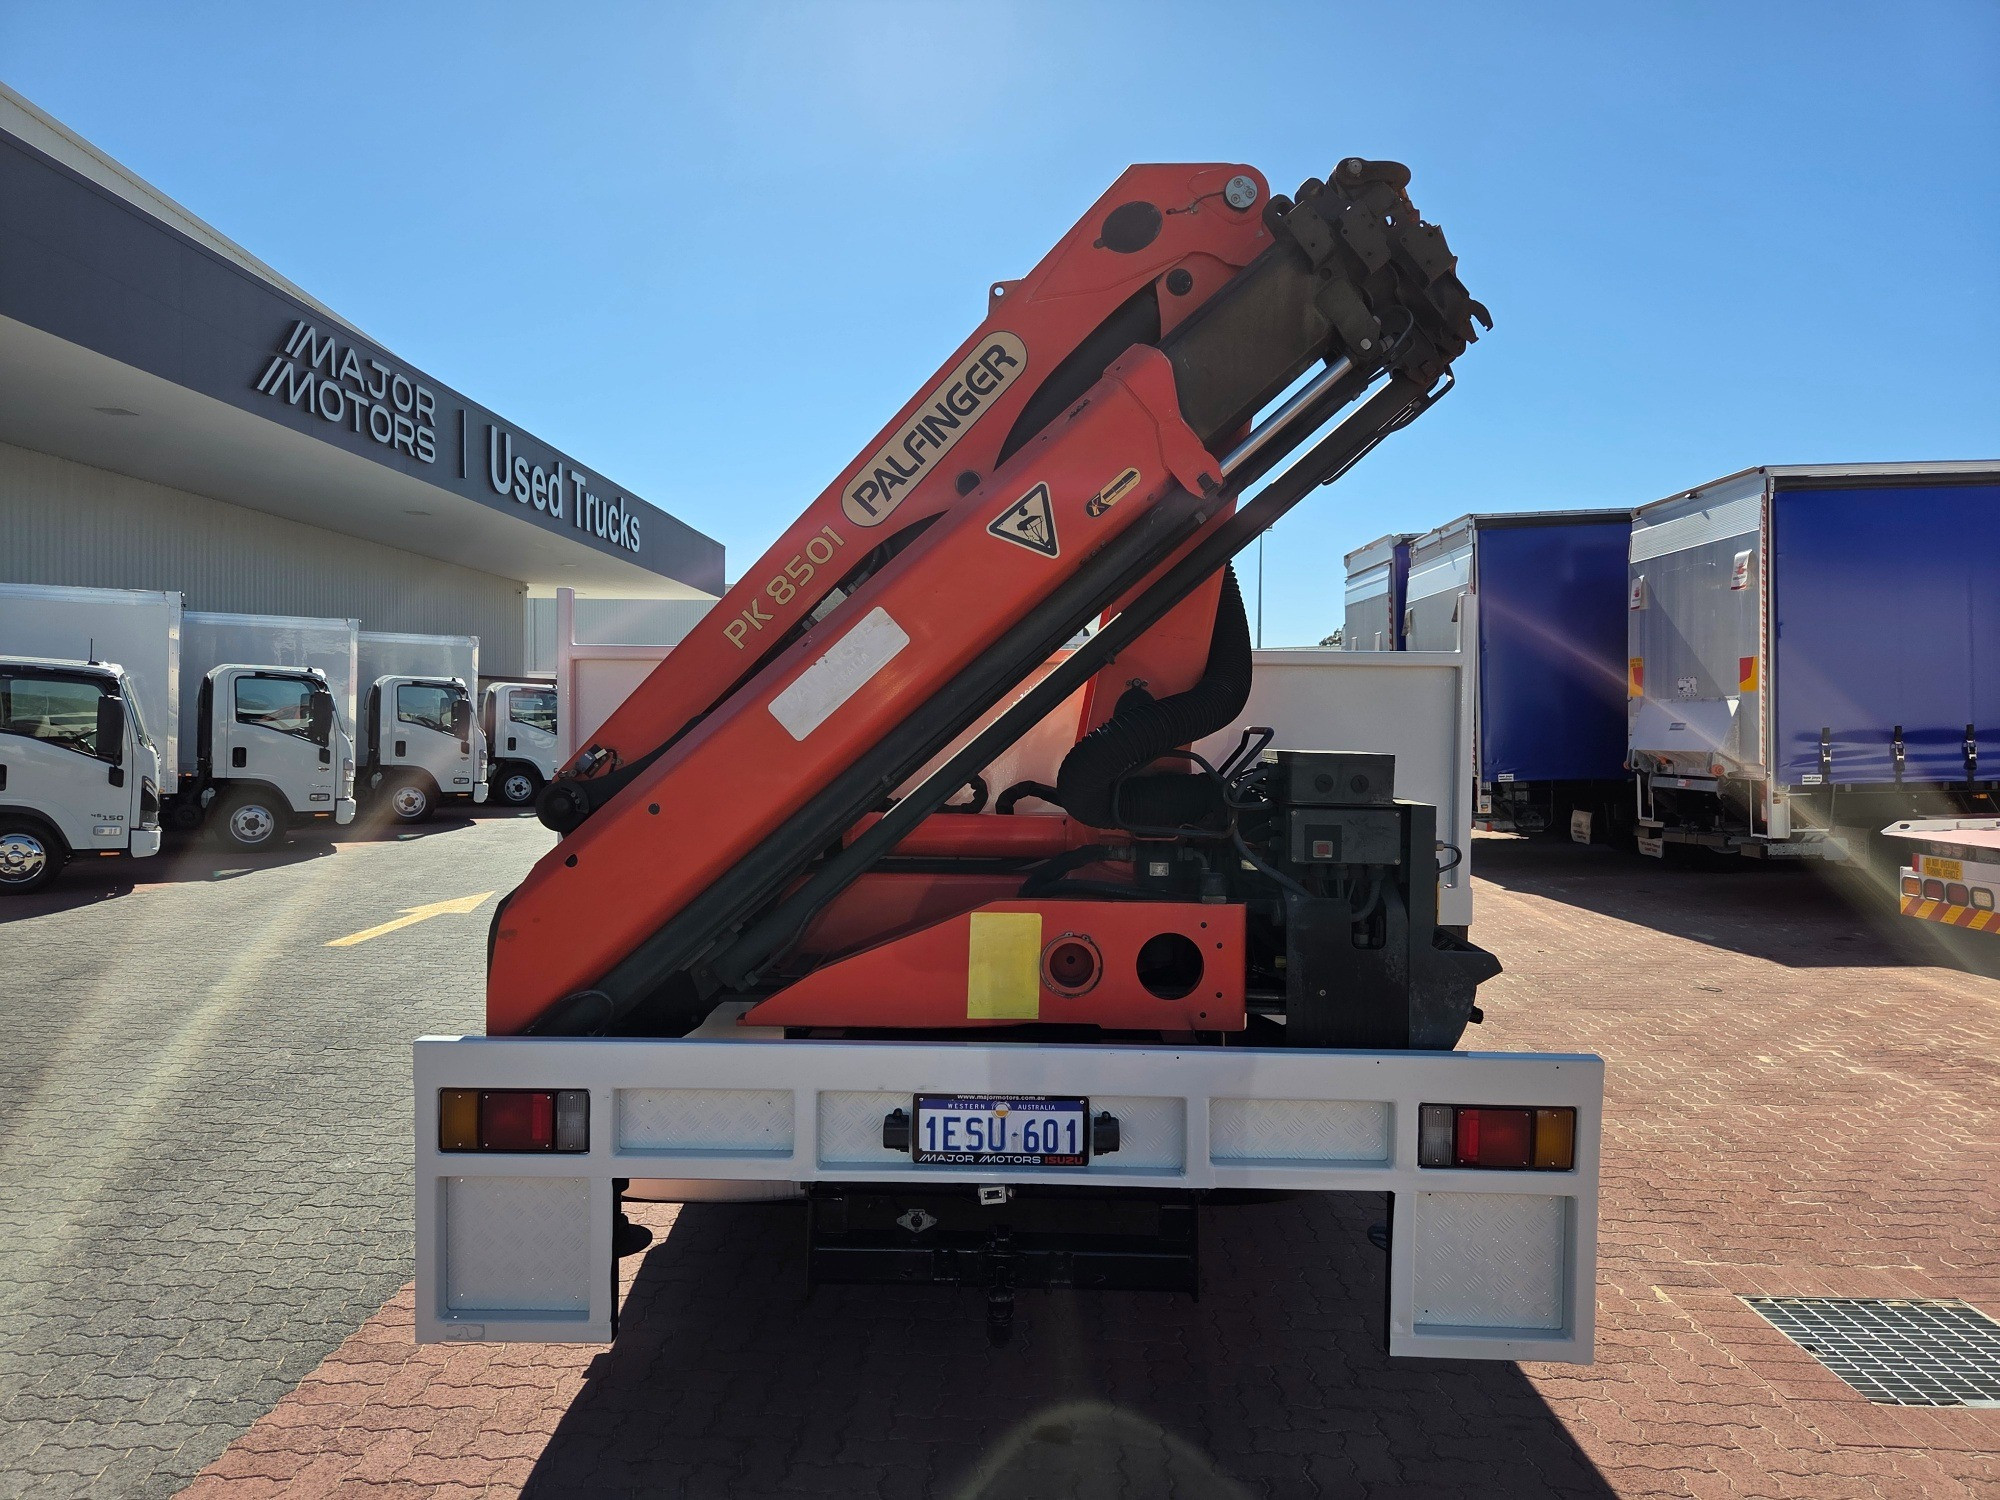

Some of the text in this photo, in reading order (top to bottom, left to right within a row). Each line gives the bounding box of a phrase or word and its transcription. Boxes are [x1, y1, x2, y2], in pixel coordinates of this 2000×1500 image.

[490, 425, 641, 553] Used Trucks
[852, 344, 1018, 517] PALFINGER
[722, 525, 845, 650] PK 8501
[918, 1153, 1084, 1165] MAJOR MOTORS ISUZU
